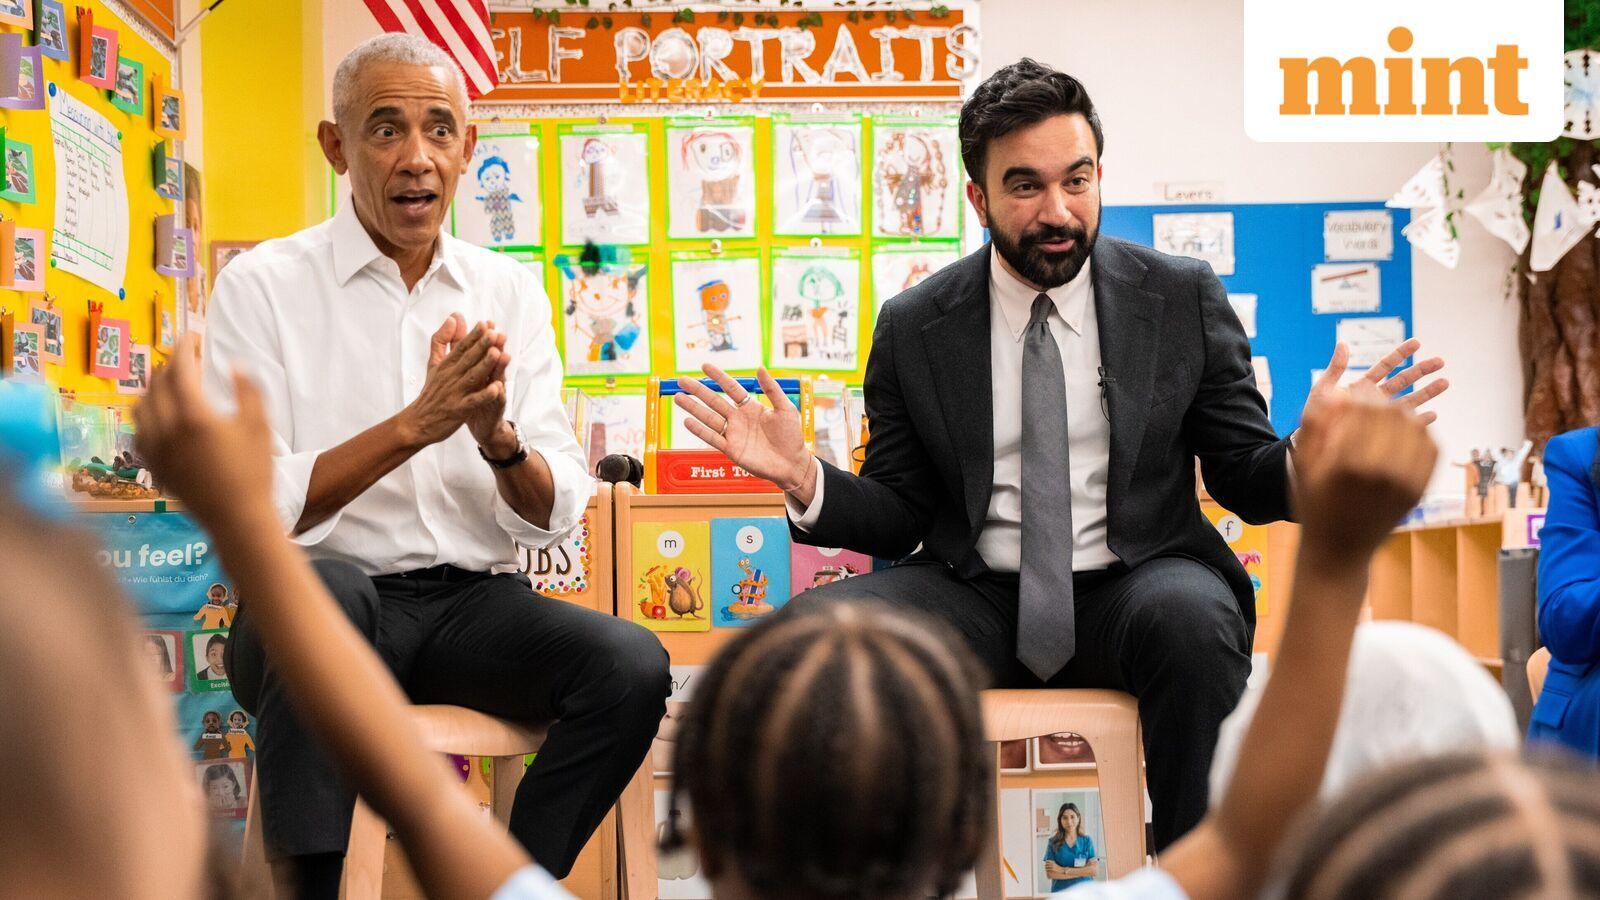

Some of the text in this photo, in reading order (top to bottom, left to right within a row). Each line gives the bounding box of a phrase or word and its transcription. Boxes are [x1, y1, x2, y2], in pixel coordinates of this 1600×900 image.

[614, 24, 979, 83] PORTRAITS
[619, 78, 765, 104] LITERACY
[690, 466, 726, 478] First
[1225, 520, 1234, 536] f
[664, 539, 677, 549] m
[96, 542, 208, 568] ou feel?
